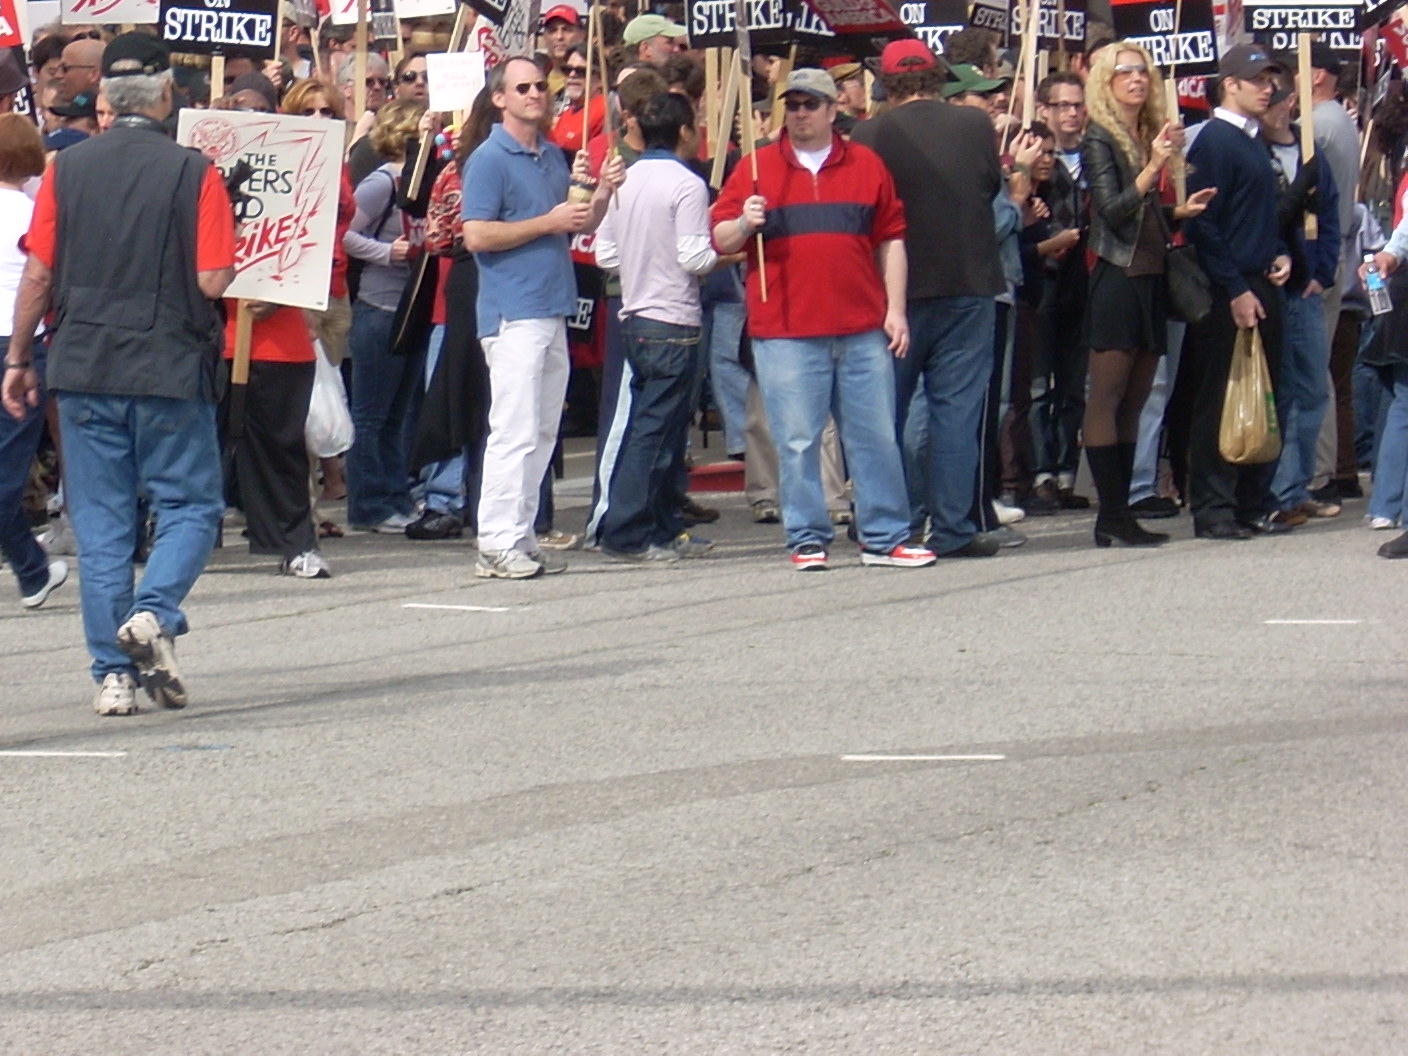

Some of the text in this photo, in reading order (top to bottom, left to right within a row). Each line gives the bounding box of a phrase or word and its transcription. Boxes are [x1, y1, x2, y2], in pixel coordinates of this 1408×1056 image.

[822, 11, 893, 25] AMERICA
[900, 3, 926, 24] ON
[1150, 9, 1174, 31] ON
[1253, 9, 1354, 29] STRIKE
[164, 8, 272, 47] STRIKE
[245, 152, 277, 166] THE
